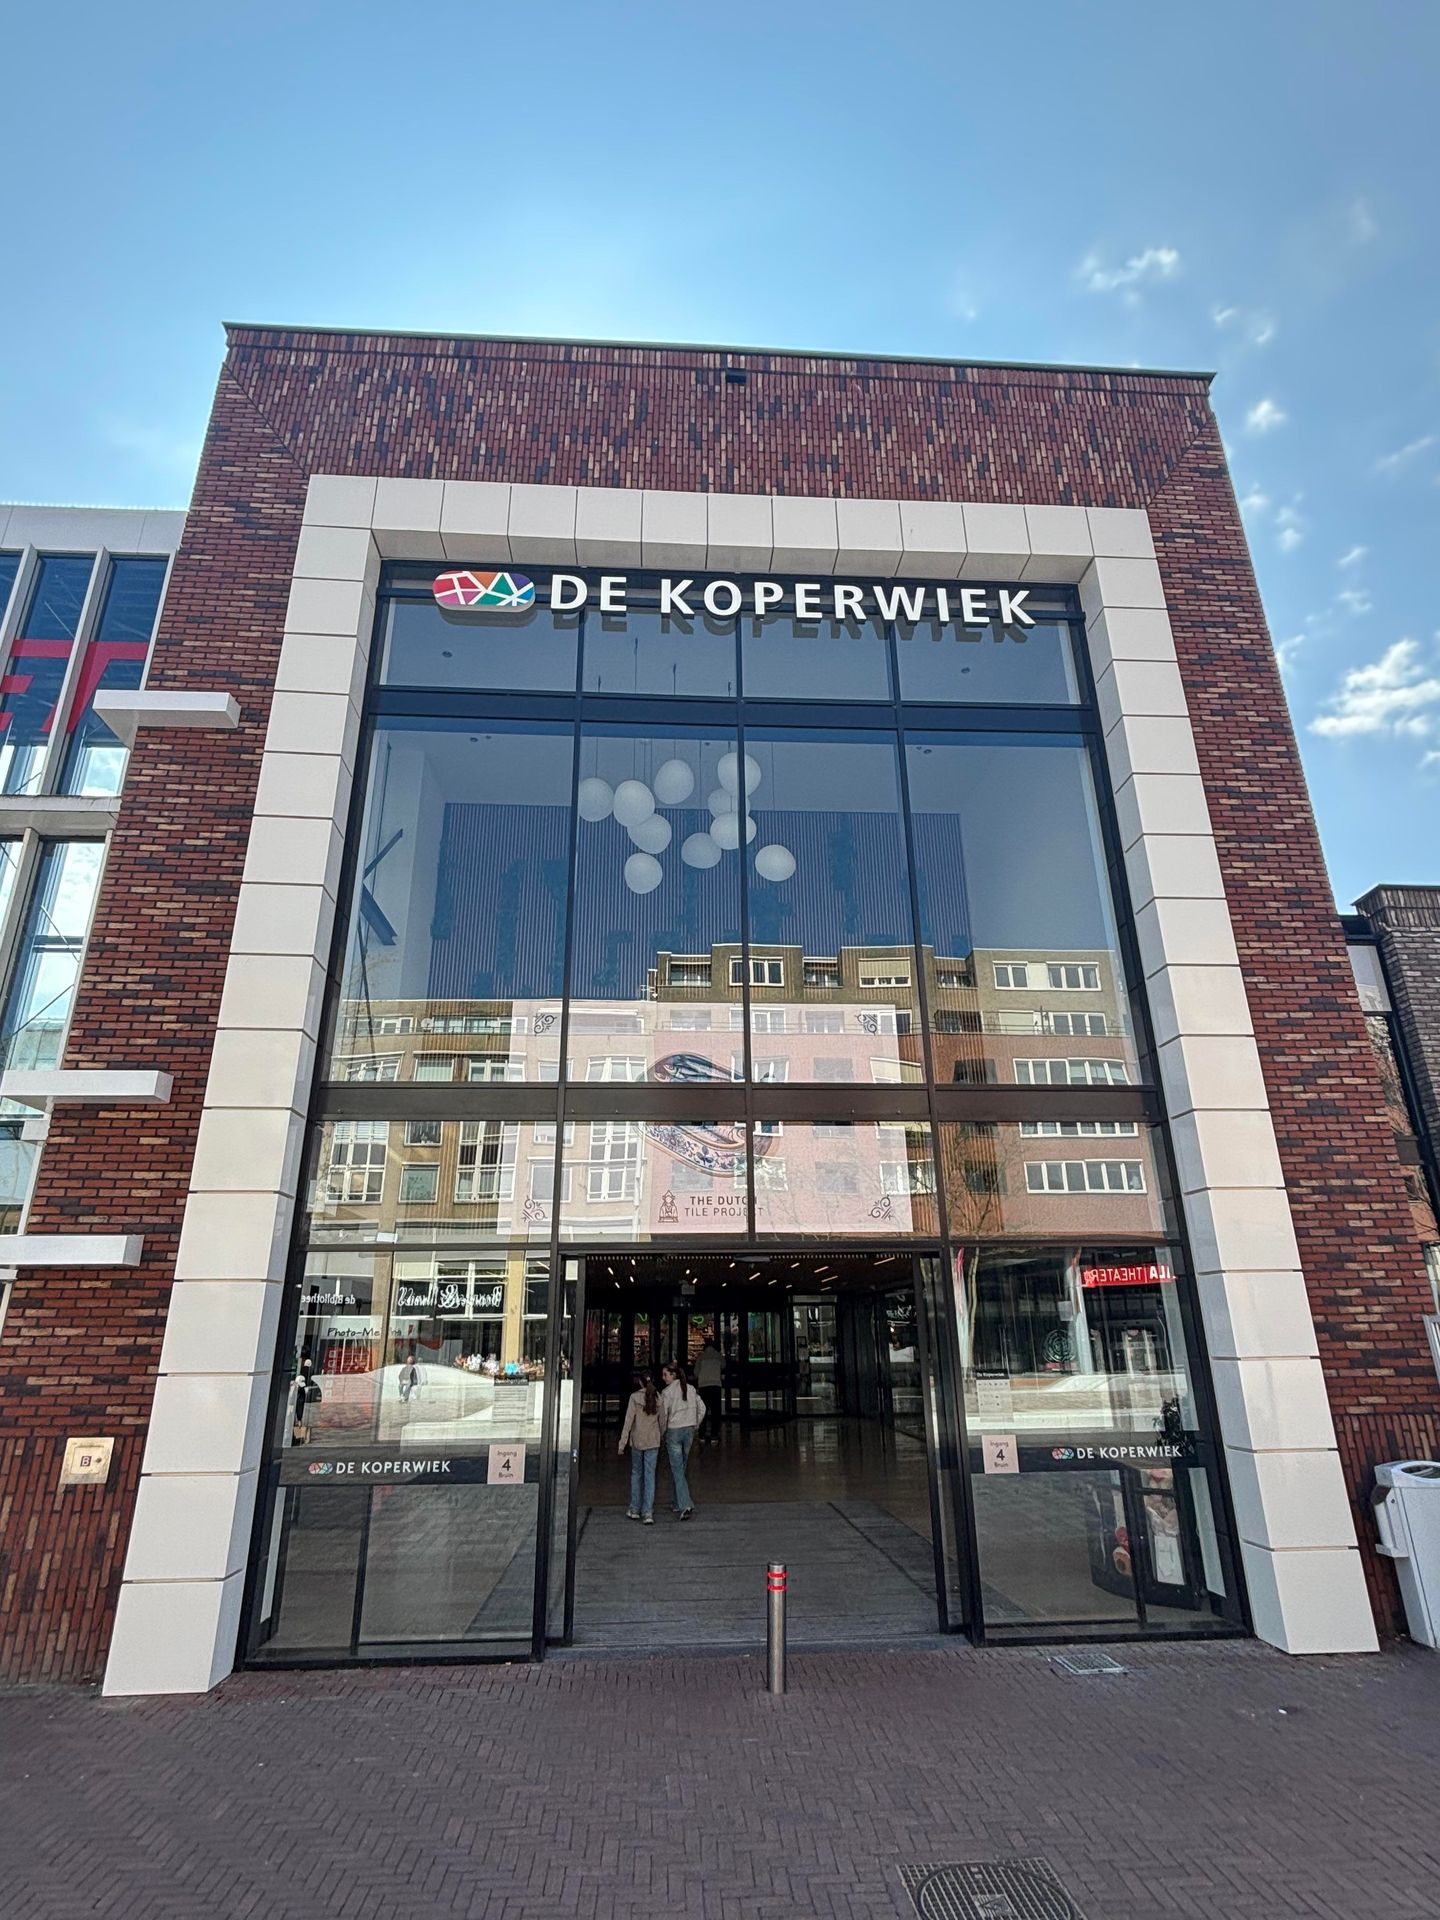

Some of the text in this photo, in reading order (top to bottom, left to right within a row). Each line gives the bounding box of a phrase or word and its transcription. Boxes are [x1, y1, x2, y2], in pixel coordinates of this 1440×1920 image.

[550, 574, 1037, 627] DE KOPERWIEK
[690, 1195, 713, 1206] THE
[684, 1207, 765, 1217] TILE PROJET
[327, 1327, 381, 1337] Photo-Me
[996, 1448, 1005, 1461] 4
[1077, 1445, 1182, 1459] DE KOPERWIEK
[82, 1456, 90, 1466] B
[335, 1460, 451, 1474] DE KOPERWIEK
[502, 1458, 511, 1471] 4
